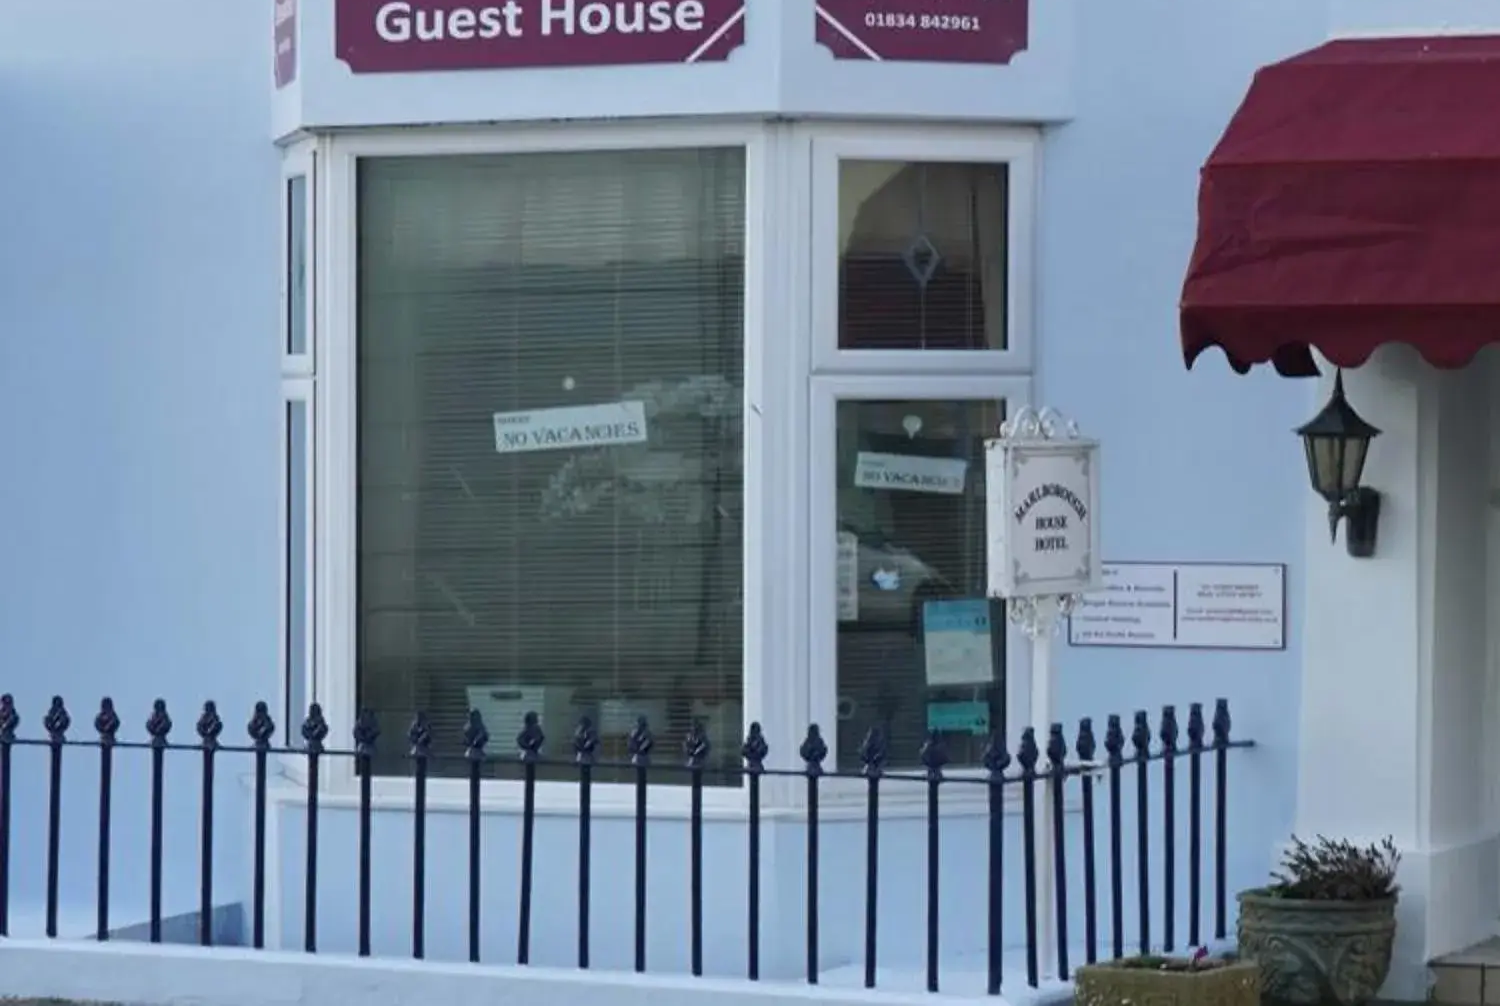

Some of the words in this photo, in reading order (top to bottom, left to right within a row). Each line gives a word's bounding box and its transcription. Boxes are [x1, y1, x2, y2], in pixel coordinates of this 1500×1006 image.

[375, 0, 523, 42] Guest
[864, 11, 916, 29] 01834
[919, 13, 981, 31] 842961
[503, 429, 528, 449] NO
[532, 421, 639, 444] VACANCIES
[1035, 515, 1068, 531] HOUSE
[1034, 536, 1070, 552] HOTEL
